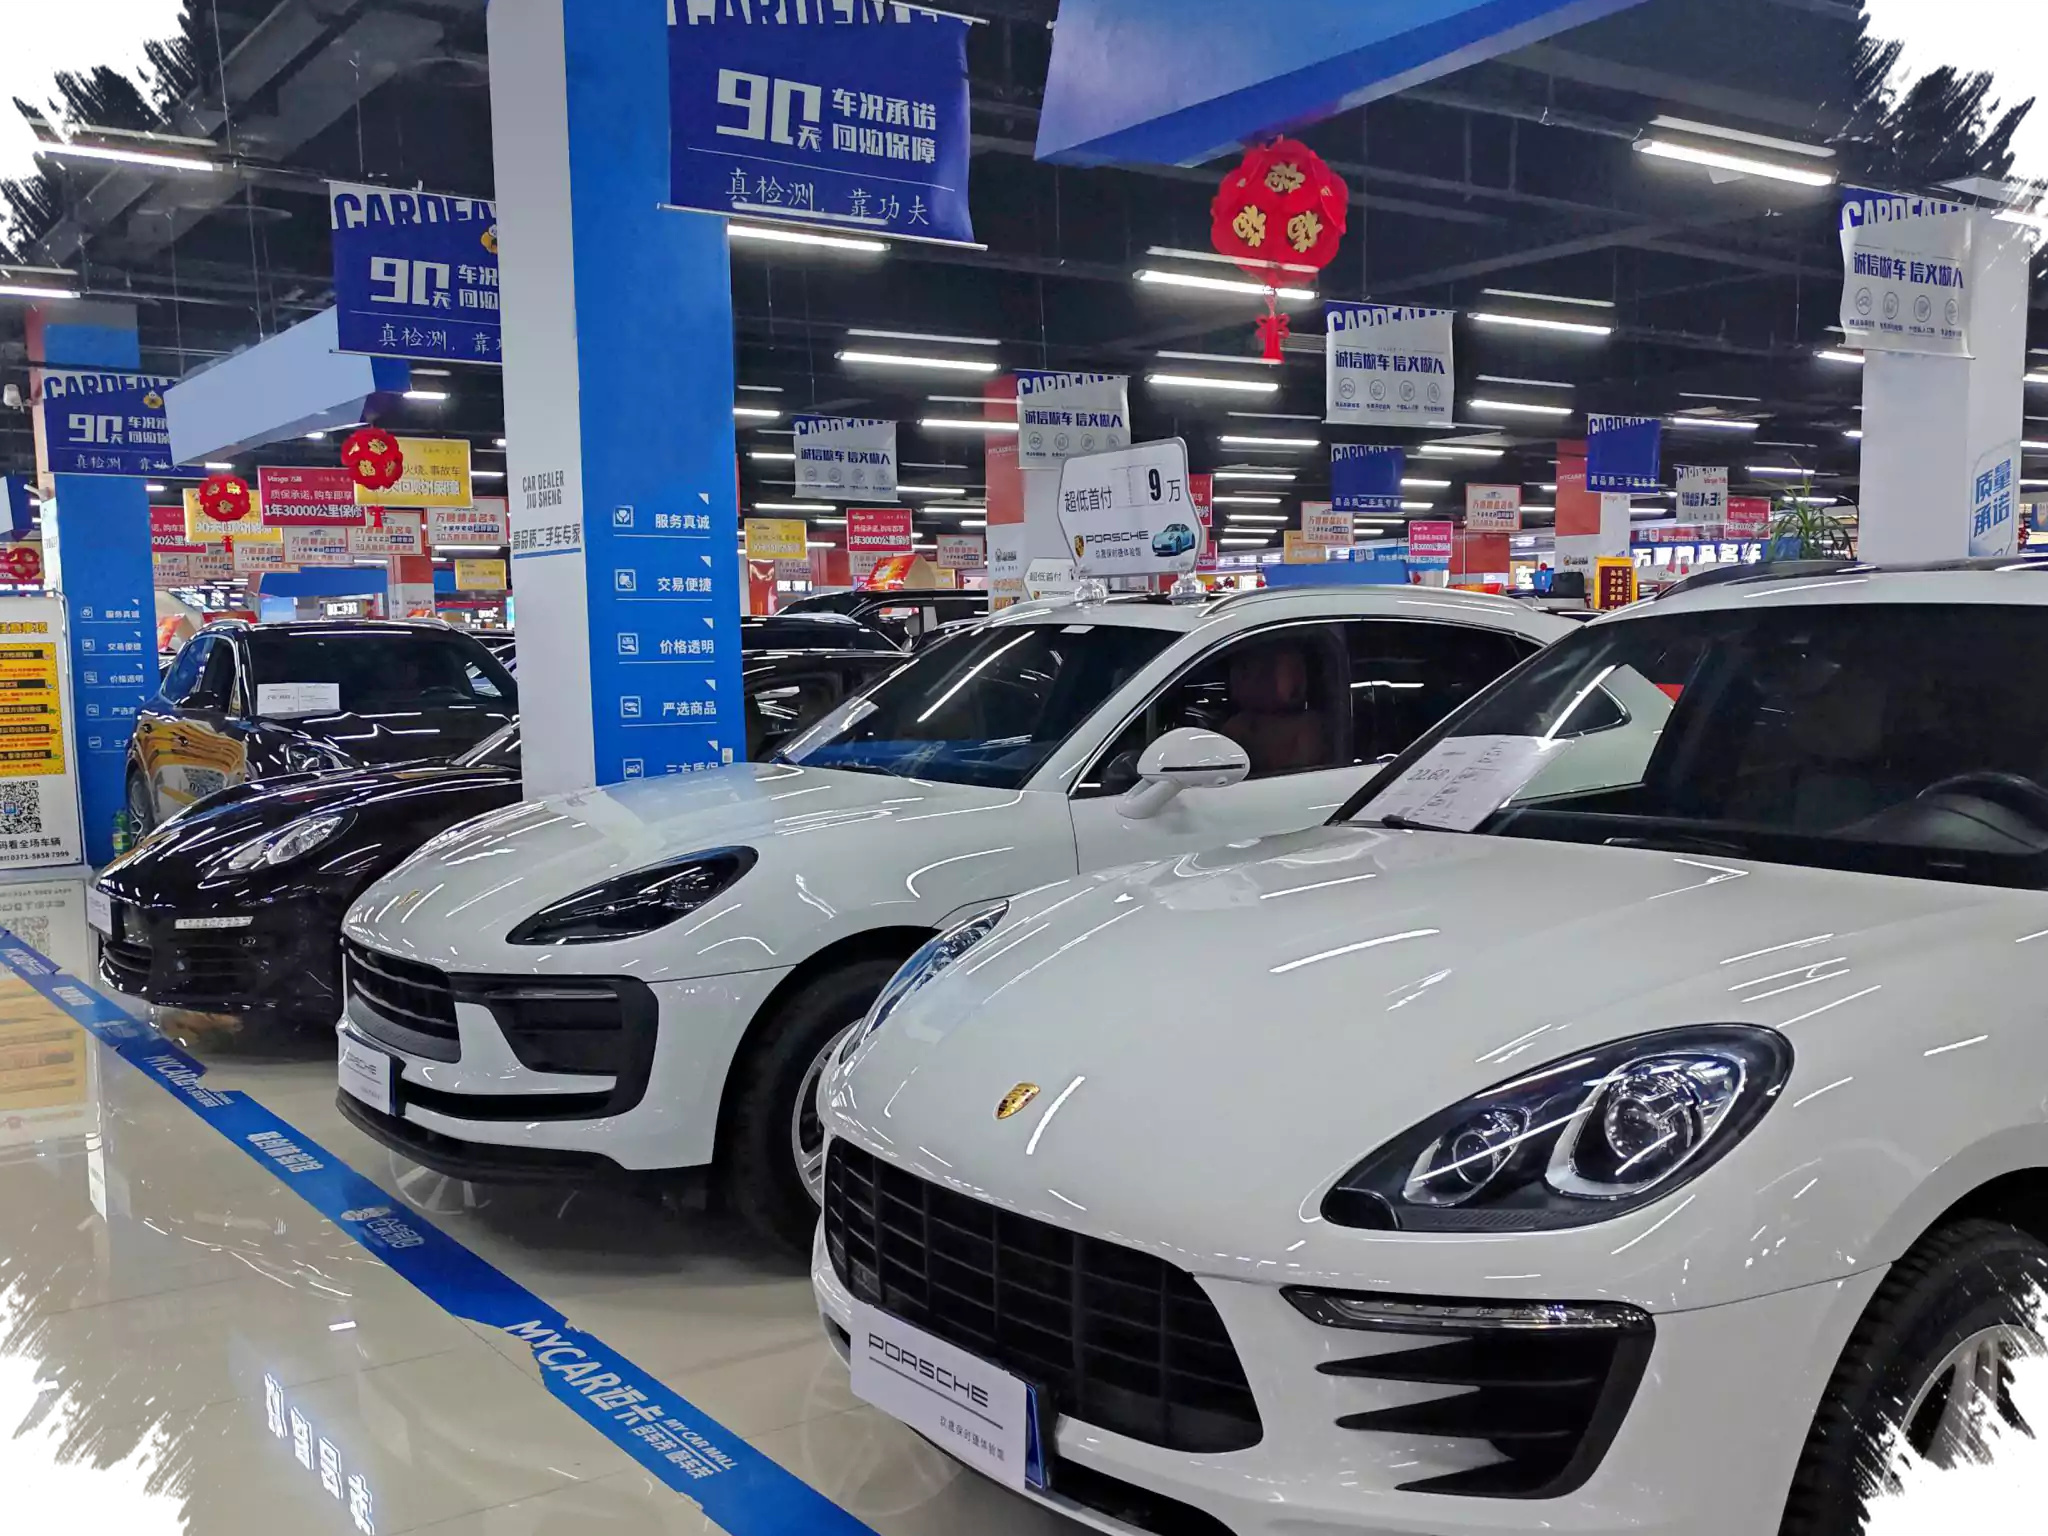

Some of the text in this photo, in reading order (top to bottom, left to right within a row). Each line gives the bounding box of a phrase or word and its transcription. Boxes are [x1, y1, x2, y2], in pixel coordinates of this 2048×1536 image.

[832, 88, 936, 130] 车况承诺
[832, 123, 936, 164] 回购保障
[847, 188, 930, 226] 靠功夫
[1853, 251, 1964, 289] 诚信做车 信义做人
[1335, 349, 1446, 375] 诚信做车 信义做人
[1025, 409, 1073, 426] 诚信做车
[801, 447, 845, 462] 诚信做车
[522, 470, 565, 493] CAR DEALER
[1064, 468, 1181, 513] 超低首付 9 万
[526, 488, 562, 509] JIU SHENG
[264, 503, 363, 518] 1年30000公里保修
[655, 513, 711, 530] 服务真诚
[513, 523, 581, 550] 高品质二手车专家
[1085, 530, 1149, 544] PORSCHE
[657, 577, 713, 593] 交易便捷
[1029, 571, 1062, 582] 超低首付
[660, 639, 714, 655] 价格透明
[662, 700, 717, 717] 严选商品
[868, 1332, 989, 1409] PORSCHE
[662, 1418, 739, 1470] MY CAR MALL
